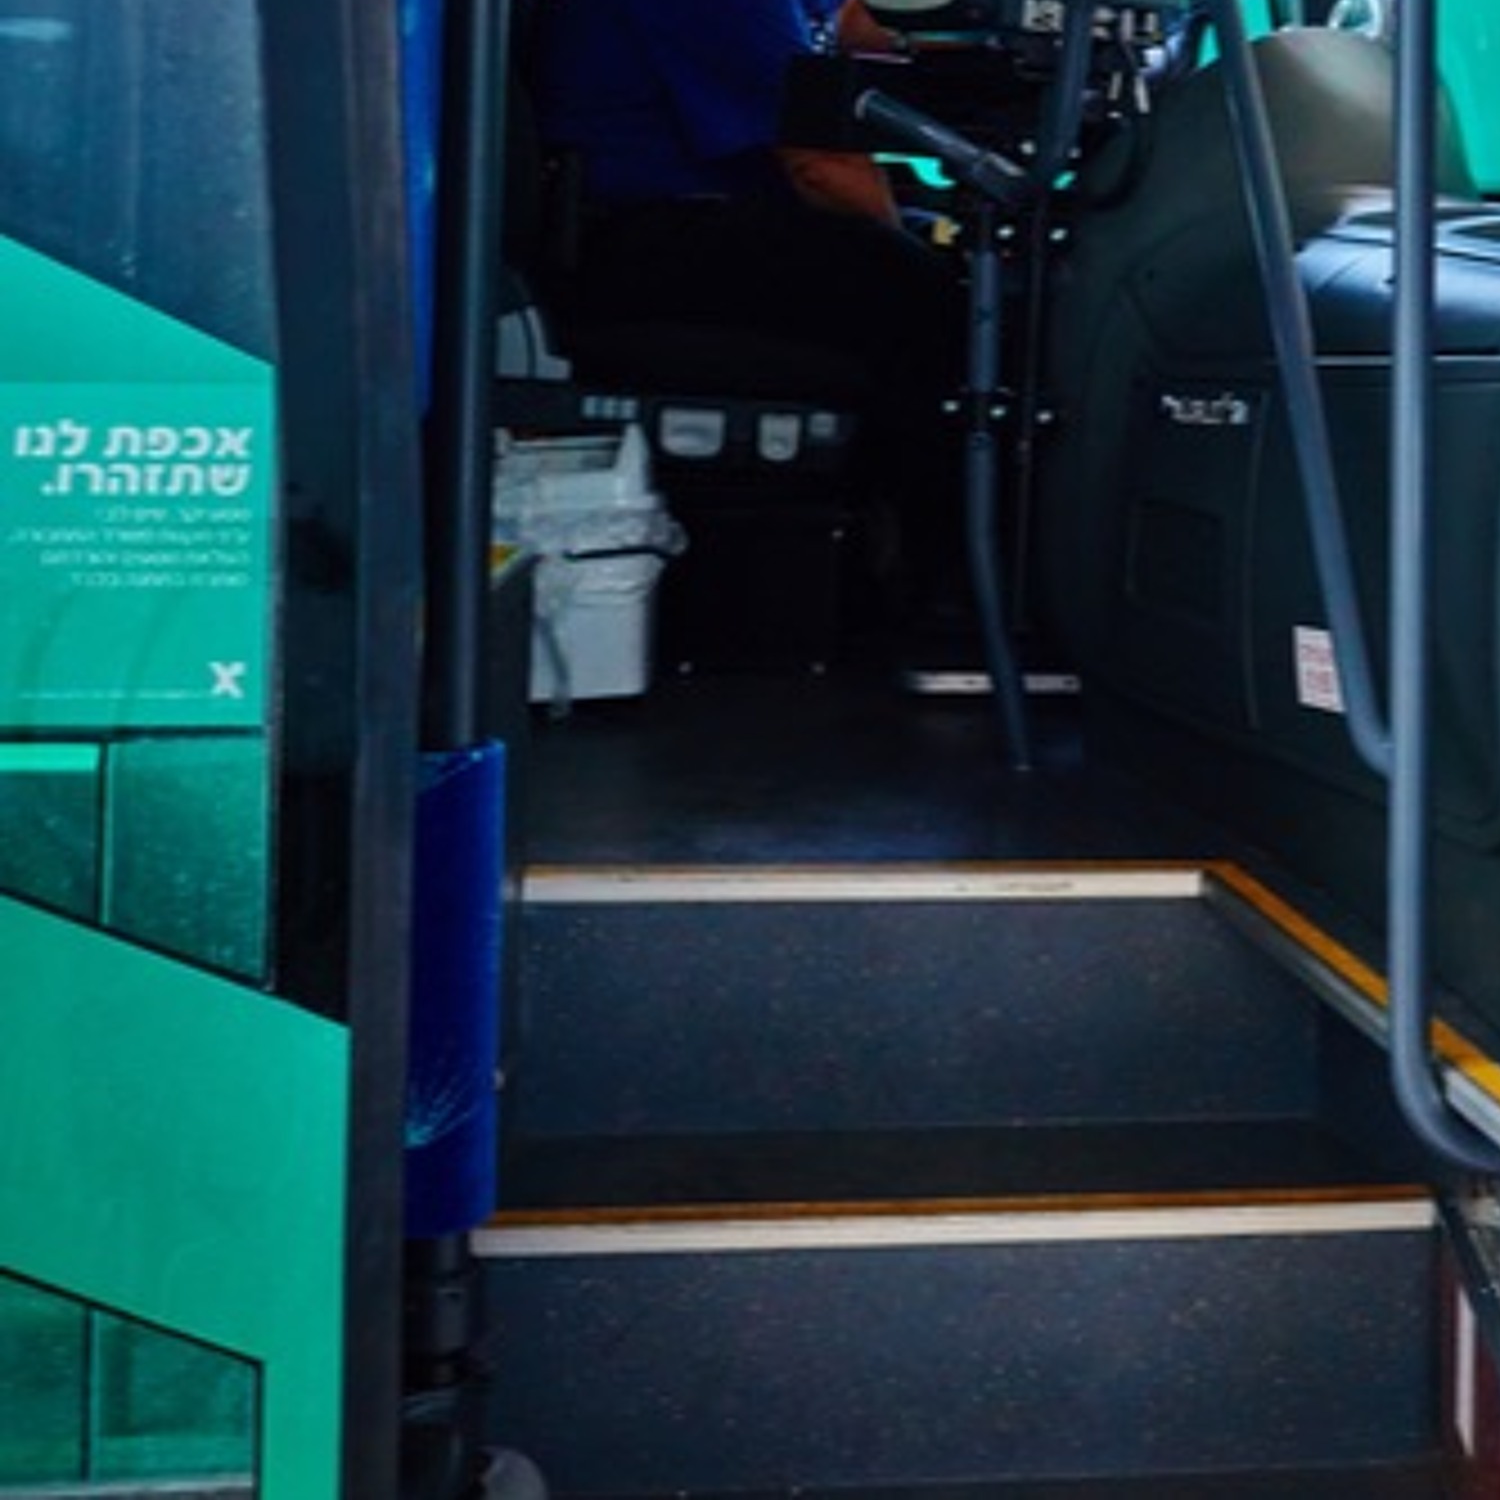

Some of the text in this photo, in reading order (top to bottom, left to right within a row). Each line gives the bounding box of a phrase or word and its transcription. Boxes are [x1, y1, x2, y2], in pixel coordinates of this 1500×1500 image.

[14, 418, 254, 458] אכפת לנו
[41, 461, 254, 497] שתזהרו.
